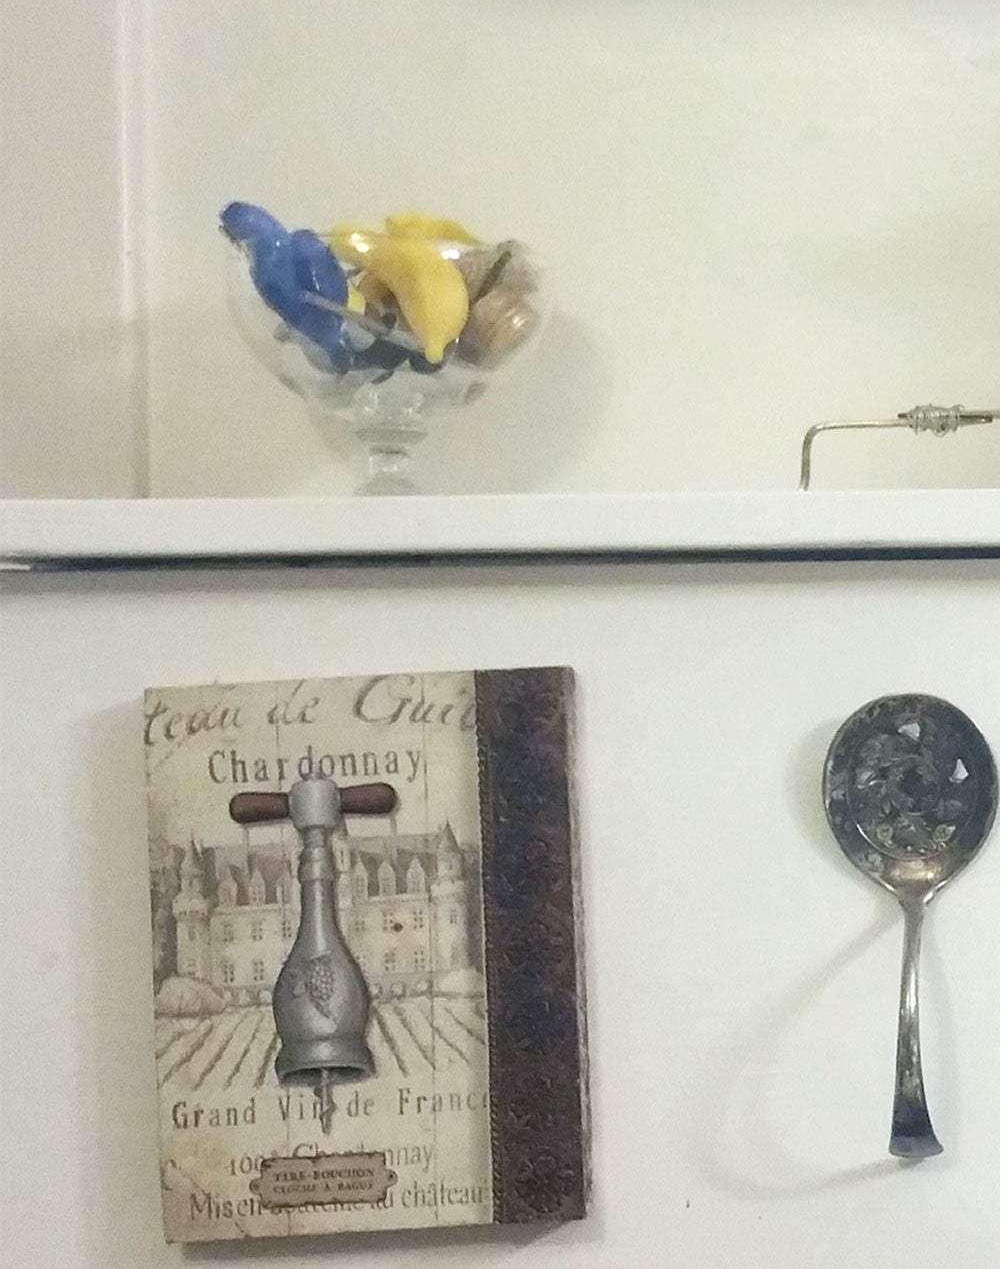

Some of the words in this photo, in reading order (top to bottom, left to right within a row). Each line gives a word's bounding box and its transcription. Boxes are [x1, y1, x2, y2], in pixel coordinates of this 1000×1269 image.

[208, 745, 422, 783] Chardonnay
[172, 1097, 256, 1129] Grand
[347, 1090, 375, 1118] de
